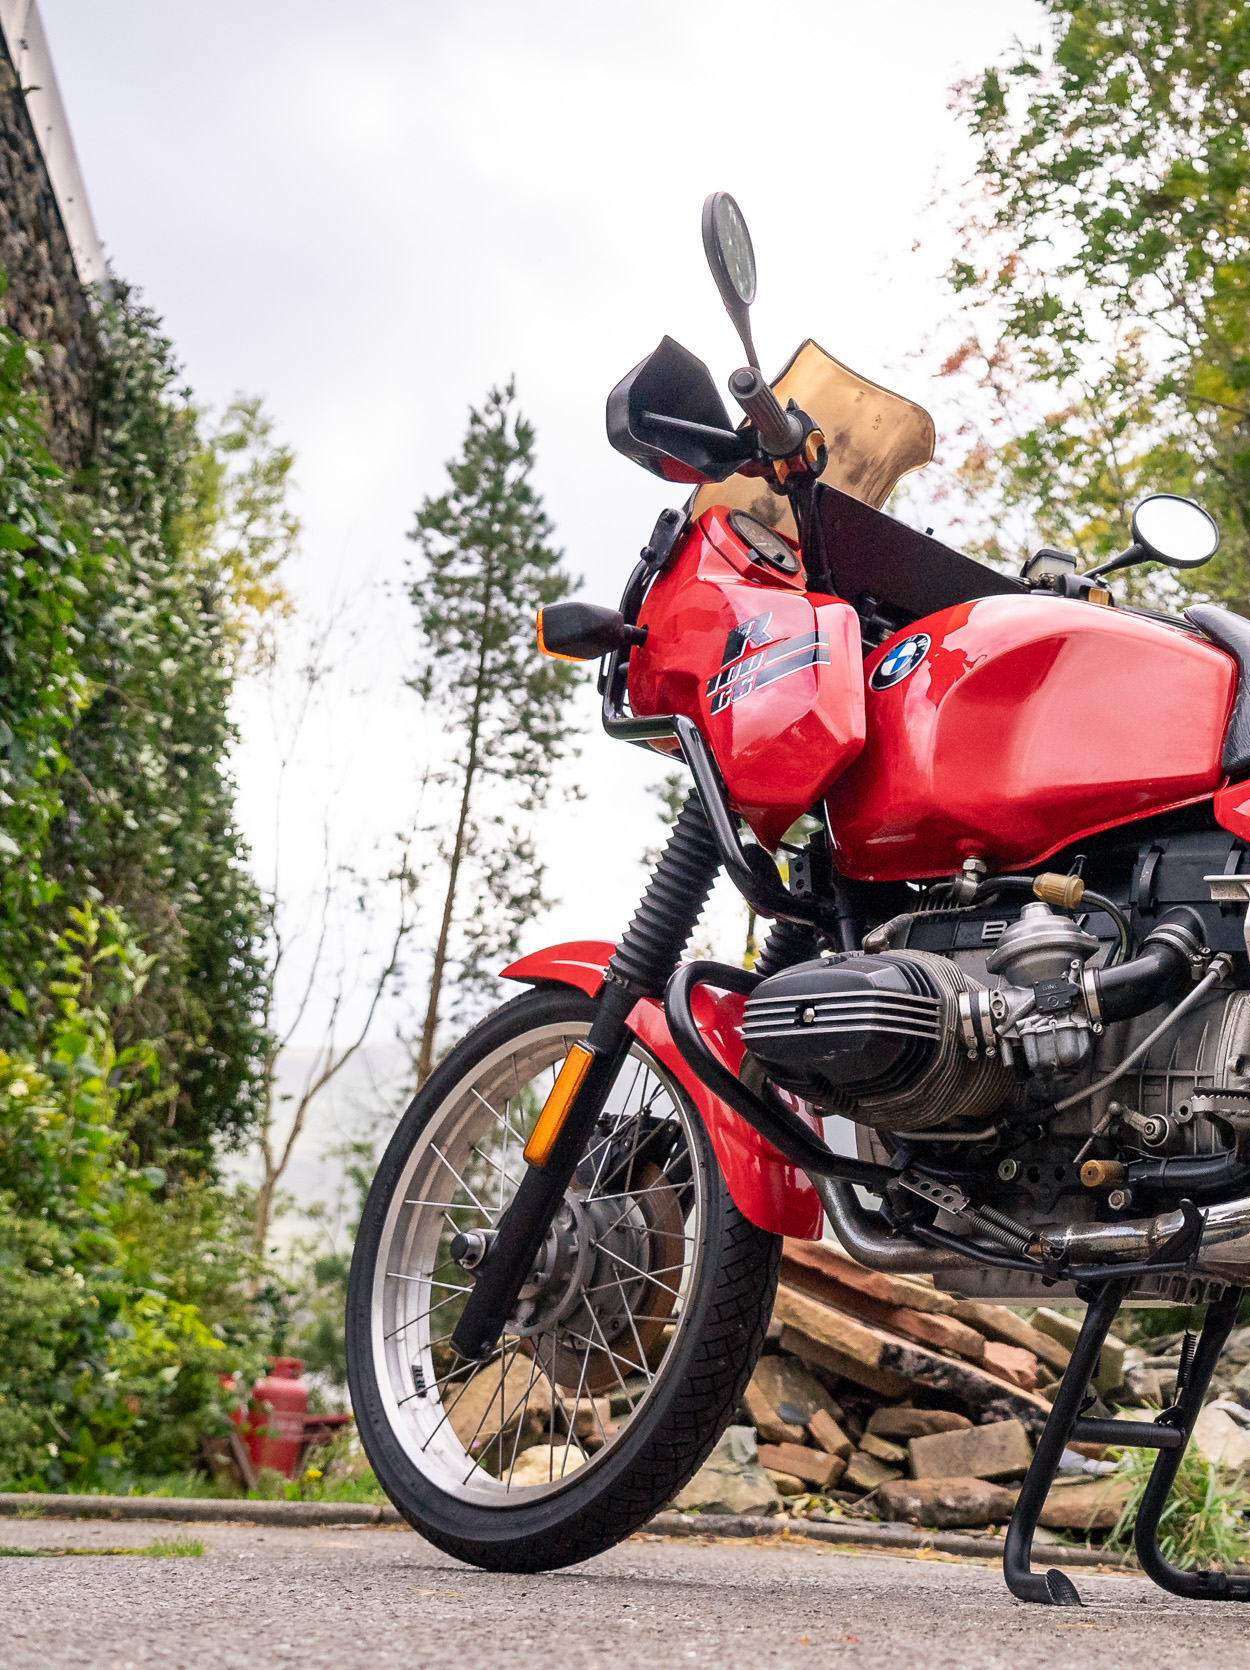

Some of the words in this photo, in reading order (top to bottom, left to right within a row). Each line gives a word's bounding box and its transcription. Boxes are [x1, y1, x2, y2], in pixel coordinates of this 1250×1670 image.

[720, 611, 773, 669] R
[706, 653, 764, 697] 100
[710, 675, 754, 716] GS
